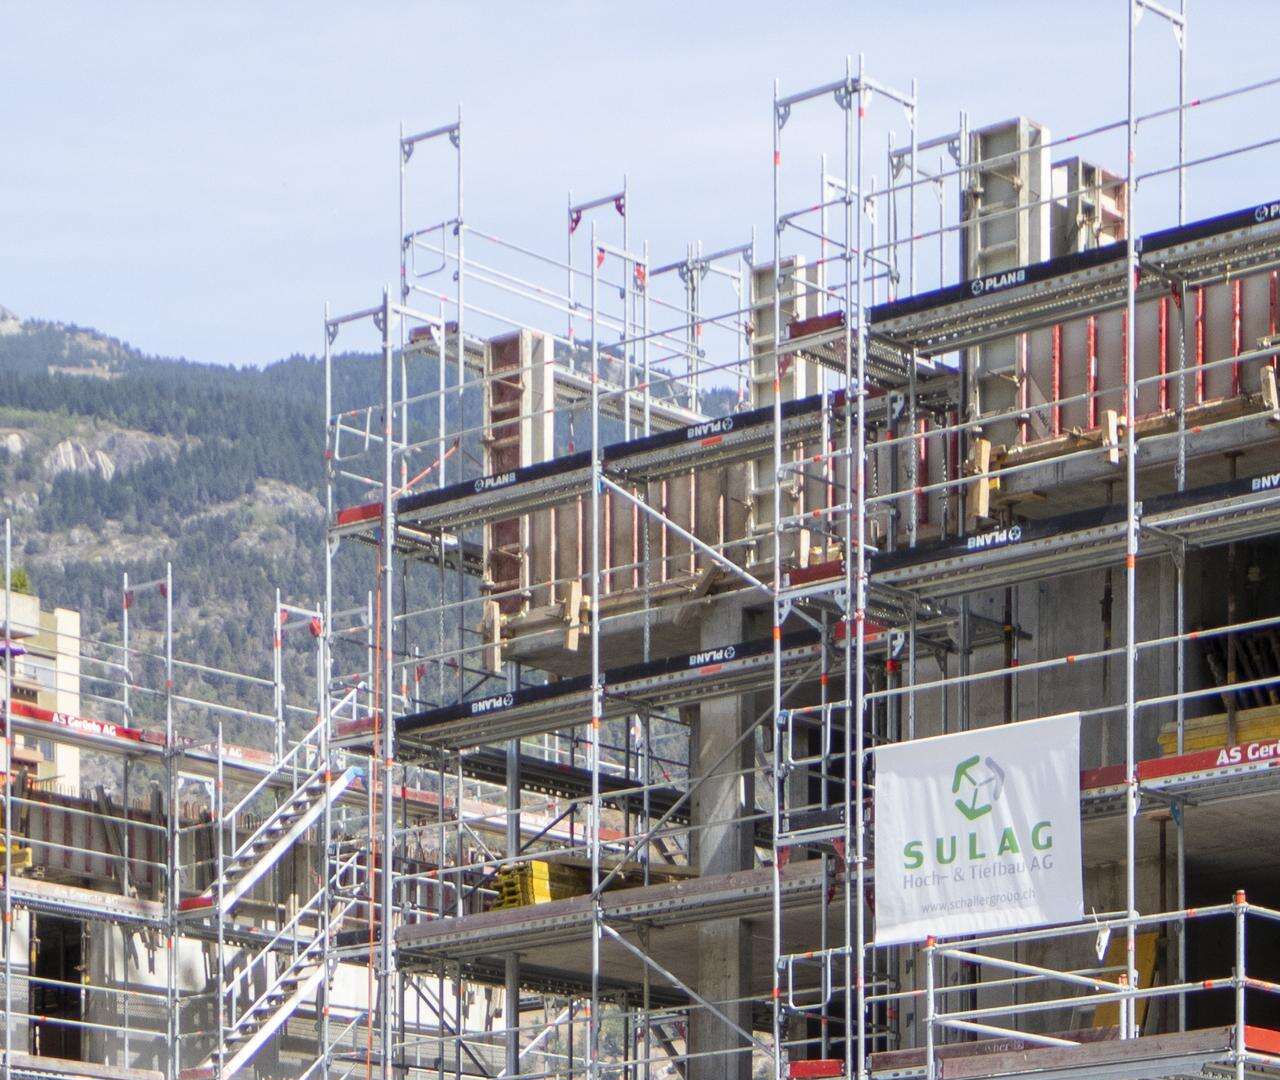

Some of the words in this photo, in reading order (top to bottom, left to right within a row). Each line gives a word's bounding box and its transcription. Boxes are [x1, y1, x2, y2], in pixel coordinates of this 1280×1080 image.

[1216, 747, 1241, 765] AS
[903, 821, 1053, 869] SULAG
[903, 870, 947, 890] Hoch-
[953, 867, 965, 882] &
[968, 861, 1026, 881] Tiefbau
[1030, 855, 1054, 872] AG
[920, 889, 1036, 913] www.schallergroup.ch
